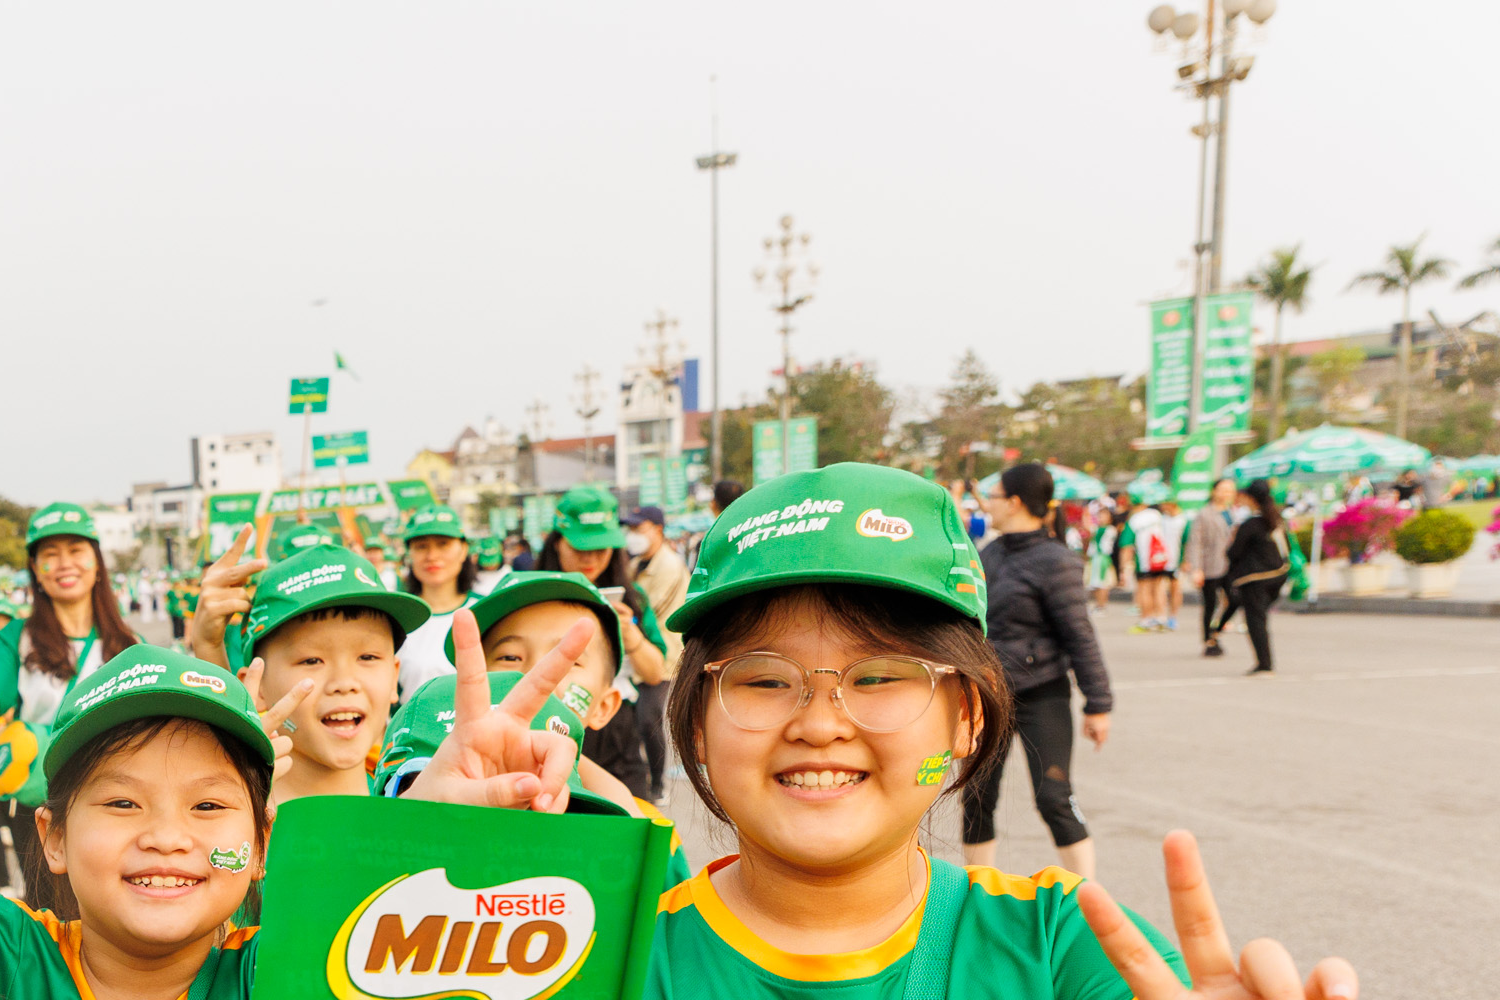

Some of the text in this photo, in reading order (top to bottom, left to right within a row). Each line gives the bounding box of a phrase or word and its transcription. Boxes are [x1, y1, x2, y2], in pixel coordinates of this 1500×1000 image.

[778, 498, 844, 518] ĐỘNG
[864, 516, 907, 535] MILO
[735, 517, 830, 554] VIỆT NAM
[117, 663, 167, 682] ĐỘNG
[187, 674, 223, 688] MILO
[117, 675, 159, 694] NAM
[476, 893, 566, 916] Nestlé
[364, 914, 568, 976] MILO
